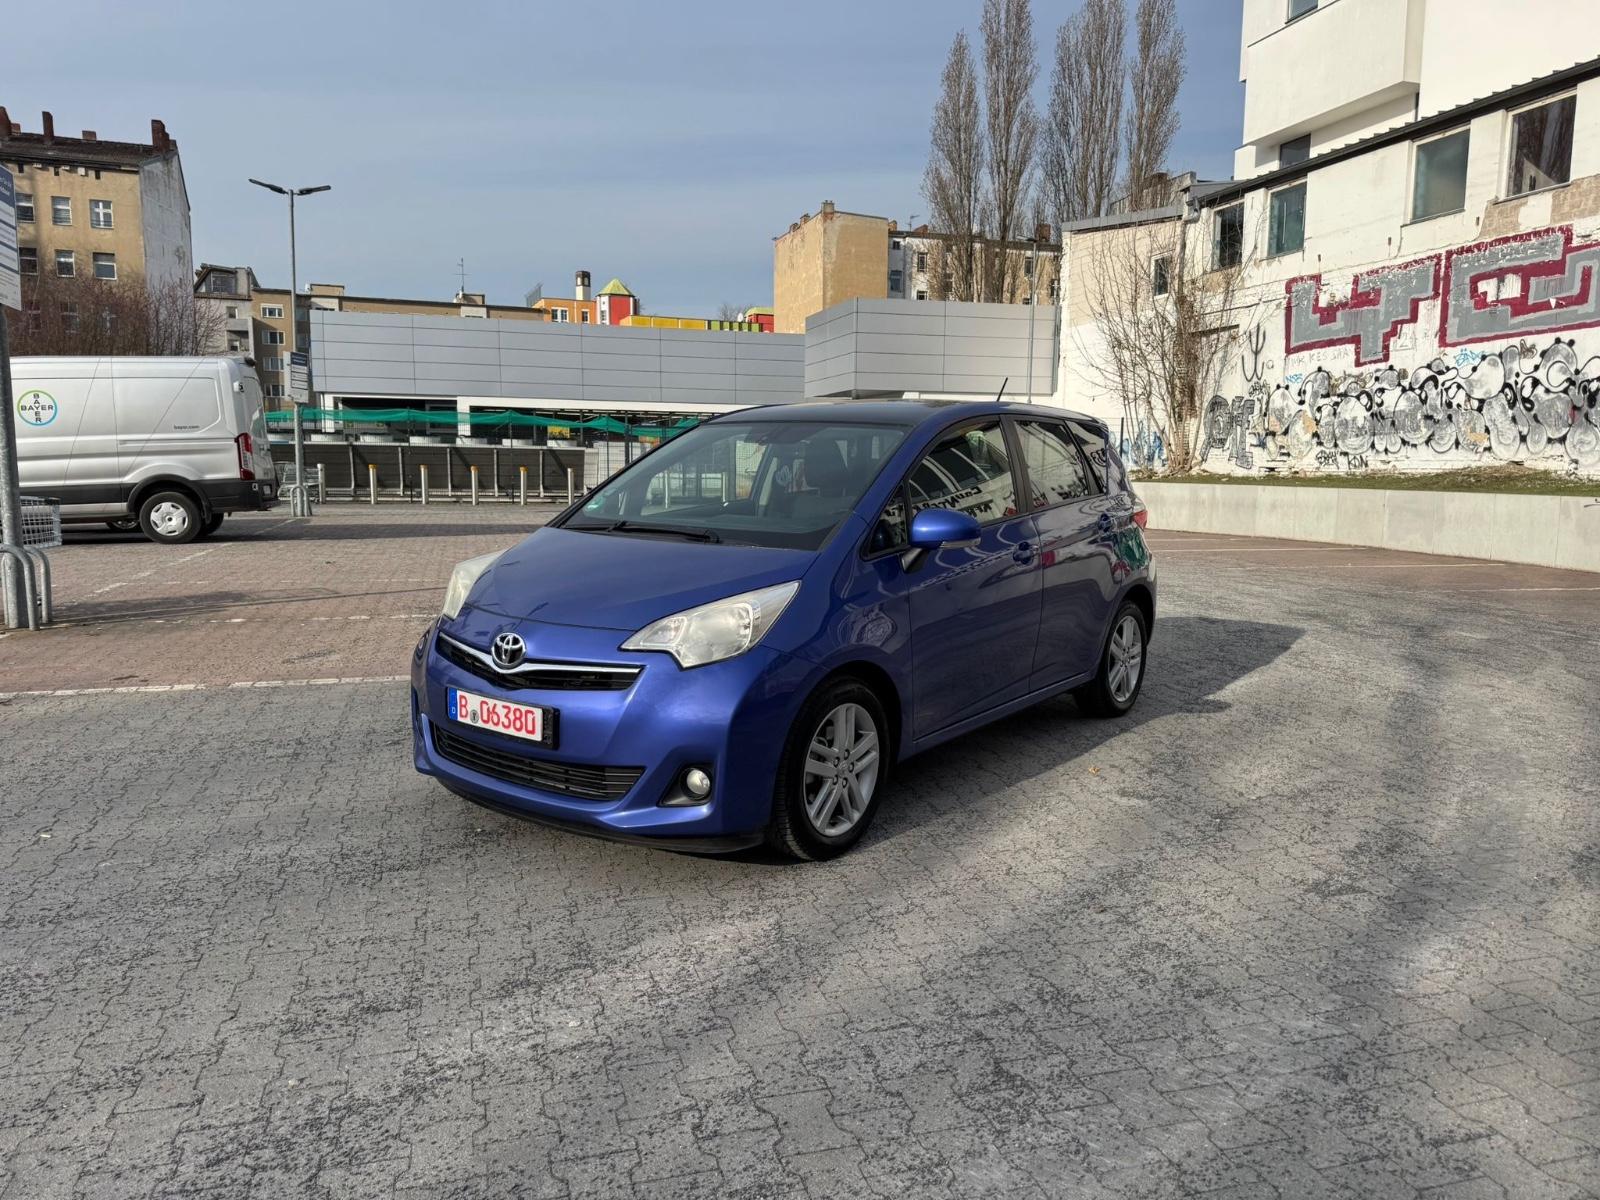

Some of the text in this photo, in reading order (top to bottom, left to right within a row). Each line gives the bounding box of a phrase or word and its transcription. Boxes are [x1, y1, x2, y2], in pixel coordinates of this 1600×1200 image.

[33, 393, 42, 423] BAYER
[459, 694, 536, 735] B 06380
